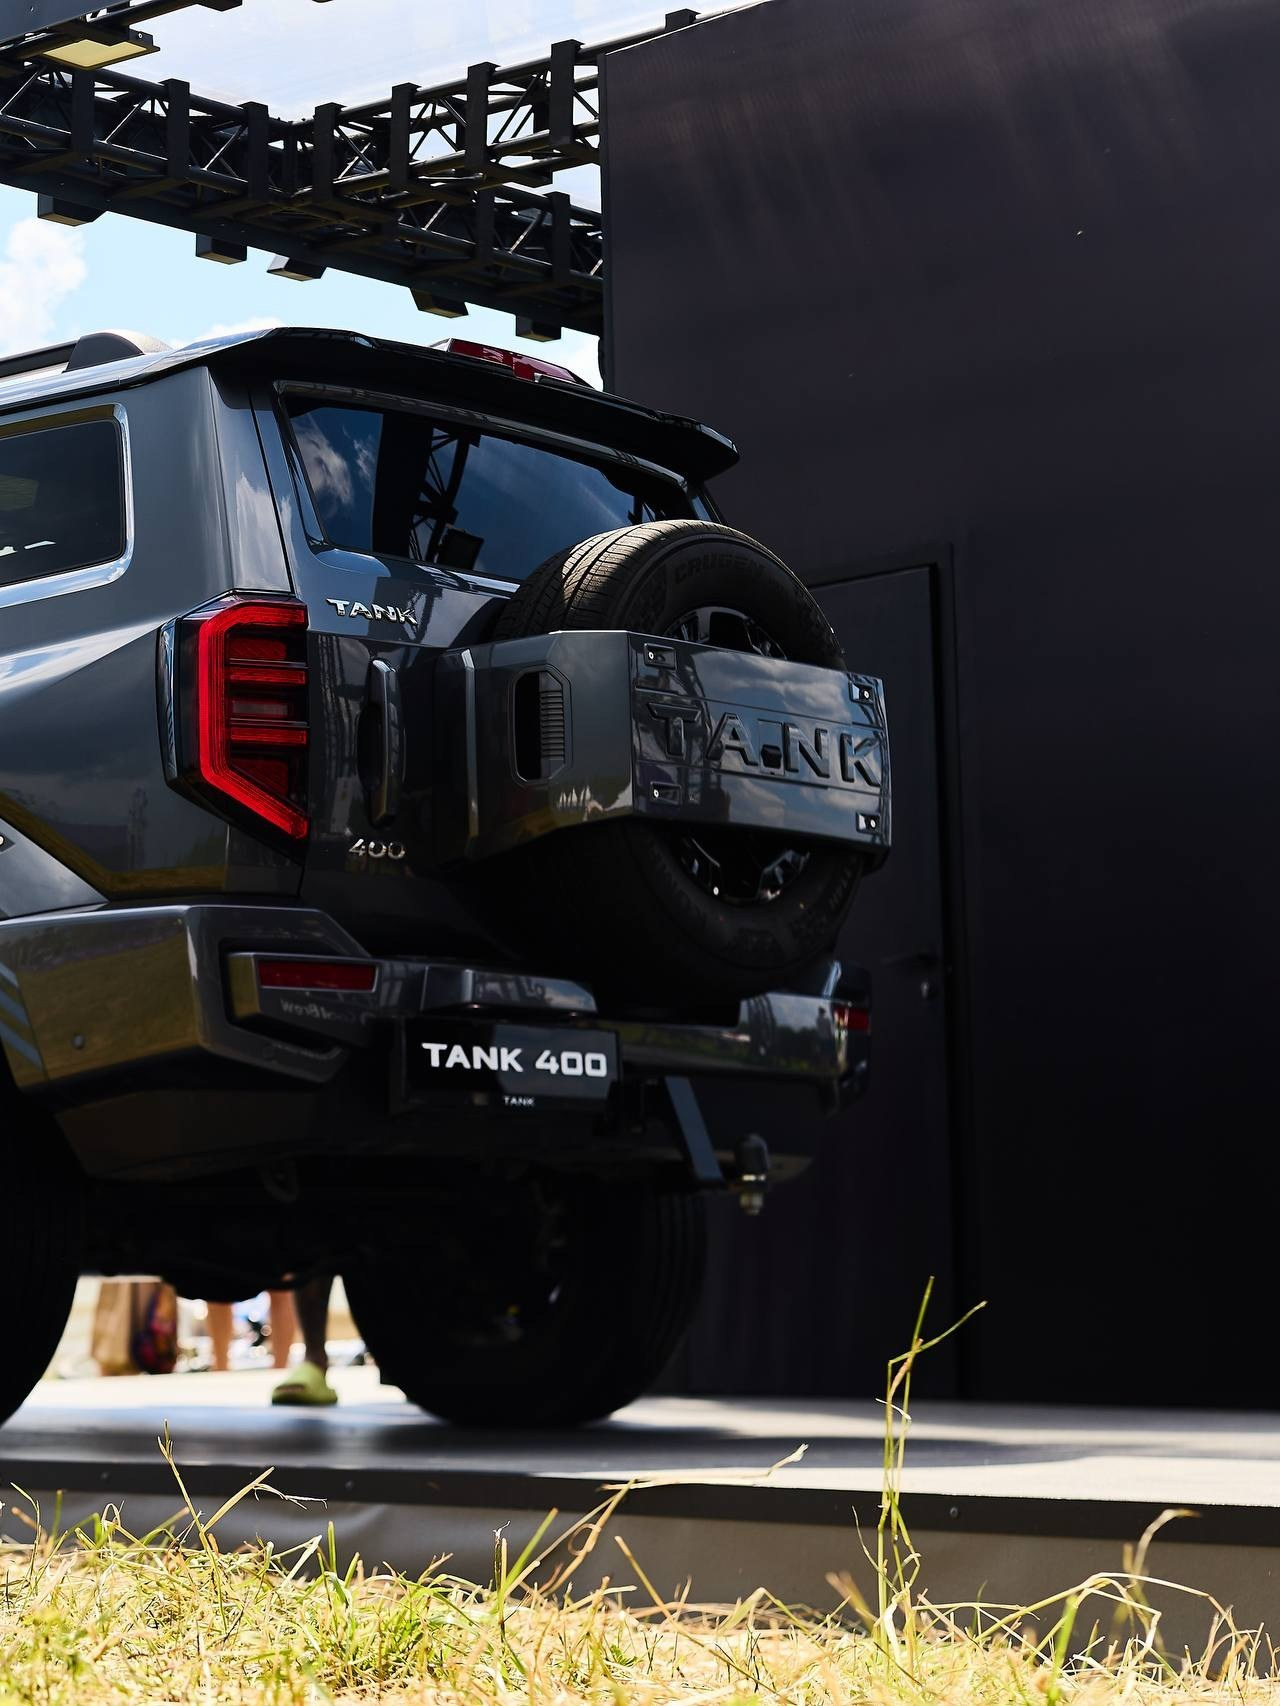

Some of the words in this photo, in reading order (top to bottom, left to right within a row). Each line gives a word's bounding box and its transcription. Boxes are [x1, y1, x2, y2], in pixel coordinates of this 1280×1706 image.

[326, 597, 418, 625] TANK
[647, 701, 882, 788] TANK
[348, 838, 406, 860] 400
[421, 1042, 524, 1072] TANK
[535, 1049, 608, 1078] 400
[503, 1095, 535, 1107] TANK
